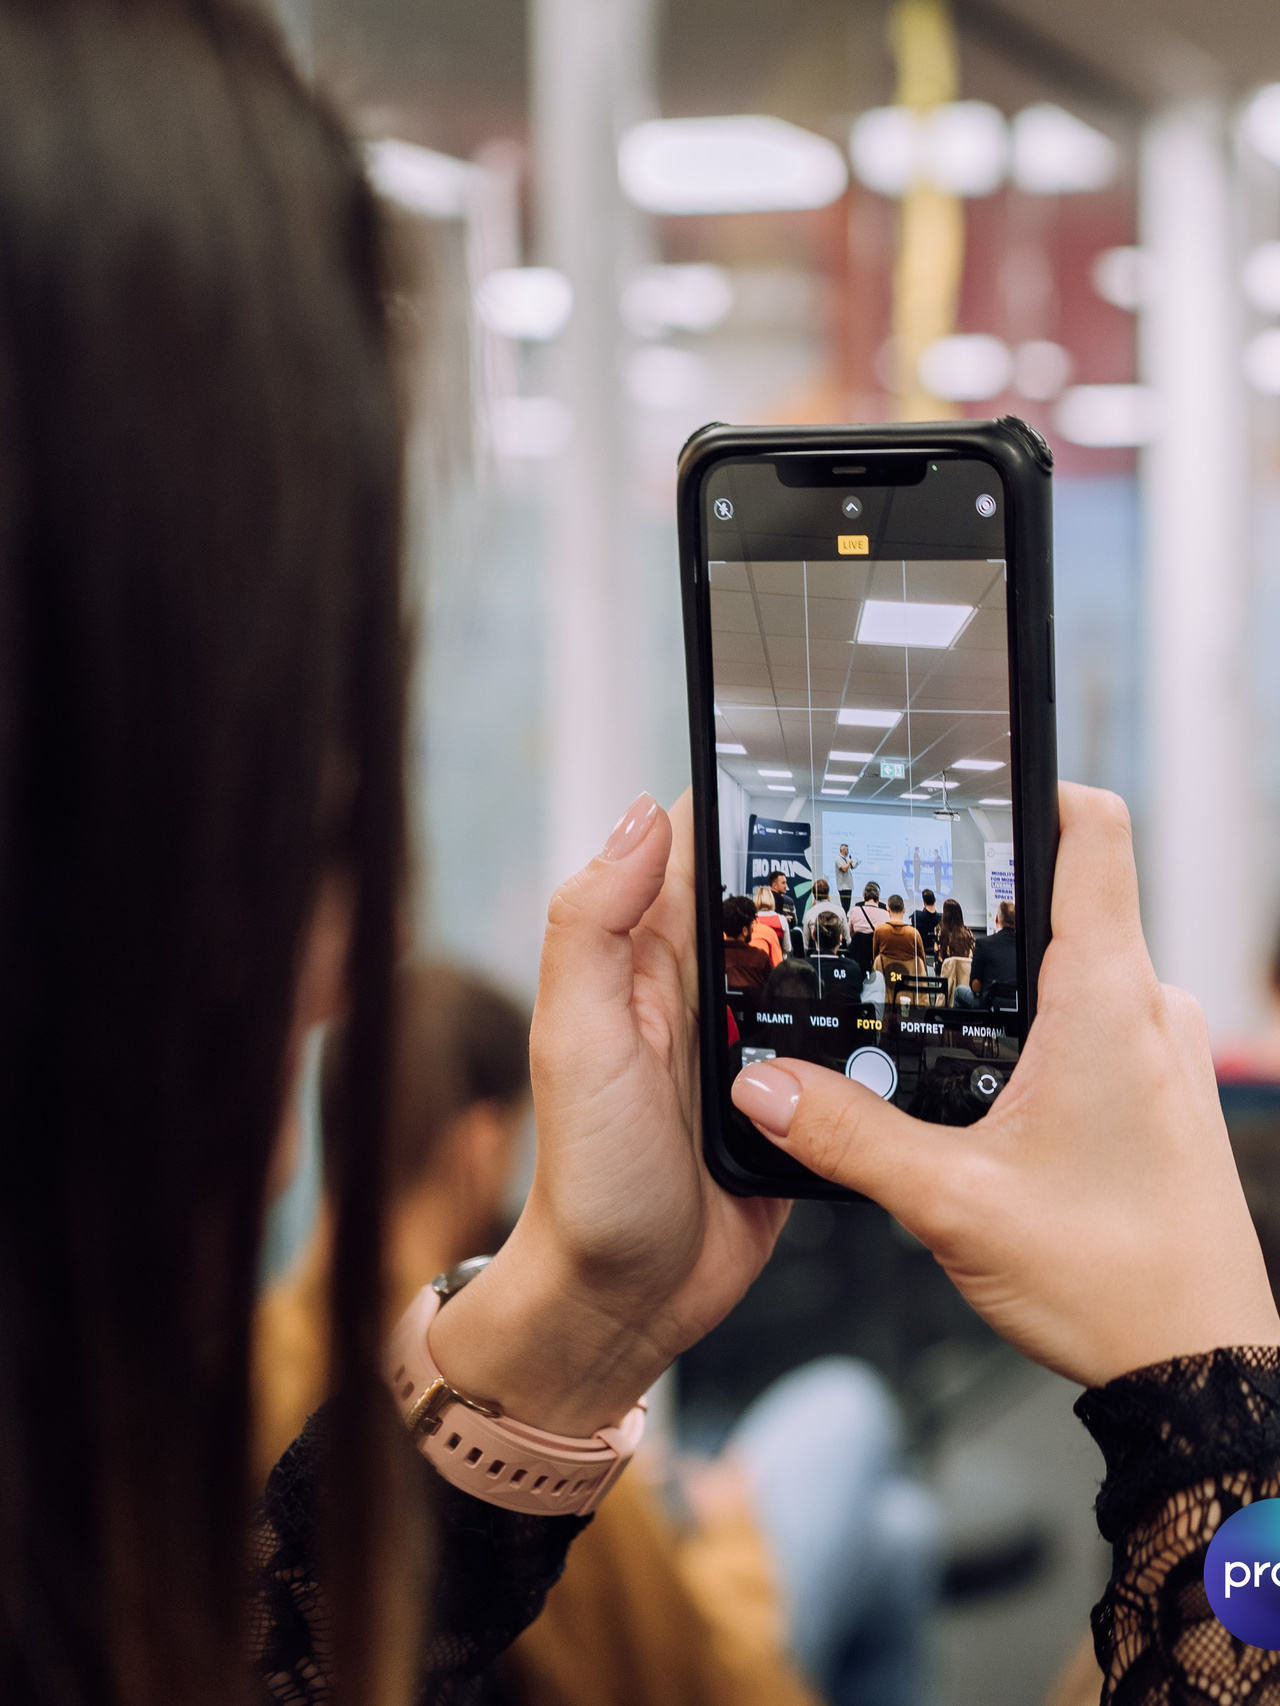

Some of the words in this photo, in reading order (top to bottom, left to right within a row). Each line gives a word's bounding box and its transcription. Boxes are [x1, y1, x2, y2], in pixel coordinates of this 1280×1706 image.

[843, 540, 864, 550] LIVE
[833, 968, 847, 980] 0,5
[865, 970, 870, 980] 1
[756, 1012, 793, 1025] RALANTI
[809, 1015, 839, 1028] VIDEO
[856, 1018, 883, 1031] FOTO
[900, 1021, 944, 1035] PORTRET
